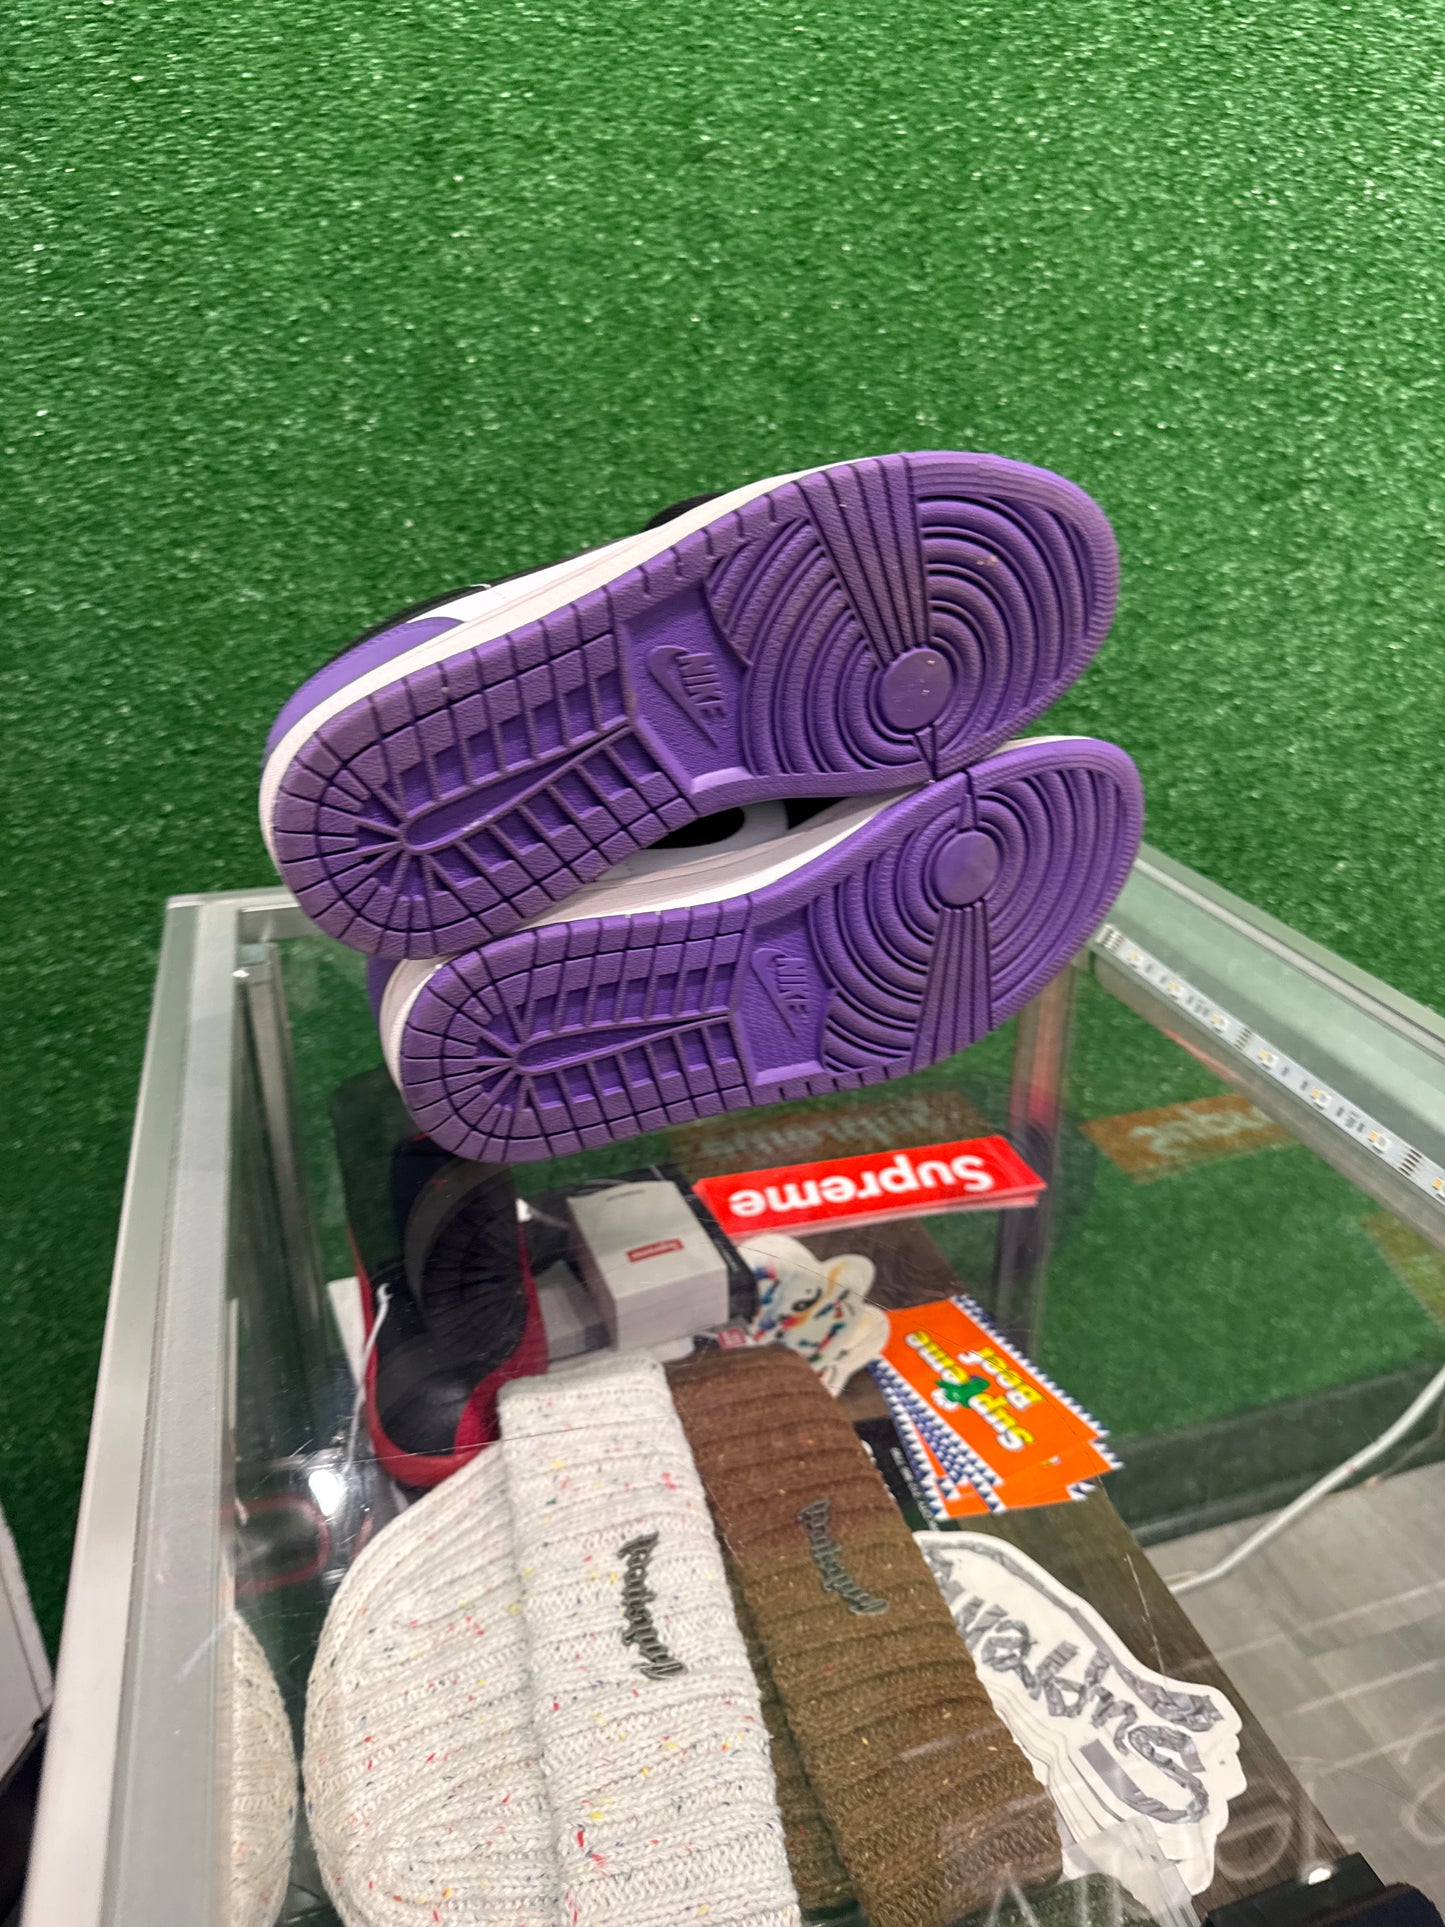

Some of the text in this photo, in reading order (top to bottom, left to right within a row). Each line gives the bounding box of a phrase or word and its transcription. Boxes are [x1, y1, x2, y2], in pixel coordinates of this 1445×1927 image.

[674, 652, 725, 718] NIKE
[775, 957, 808, 1013] NIKE
[728, 1153, 994, 1218] Supreme
[957, 1346, 1044, 1411] Beef
[922, 1547, 1210, 1824] Suprem
